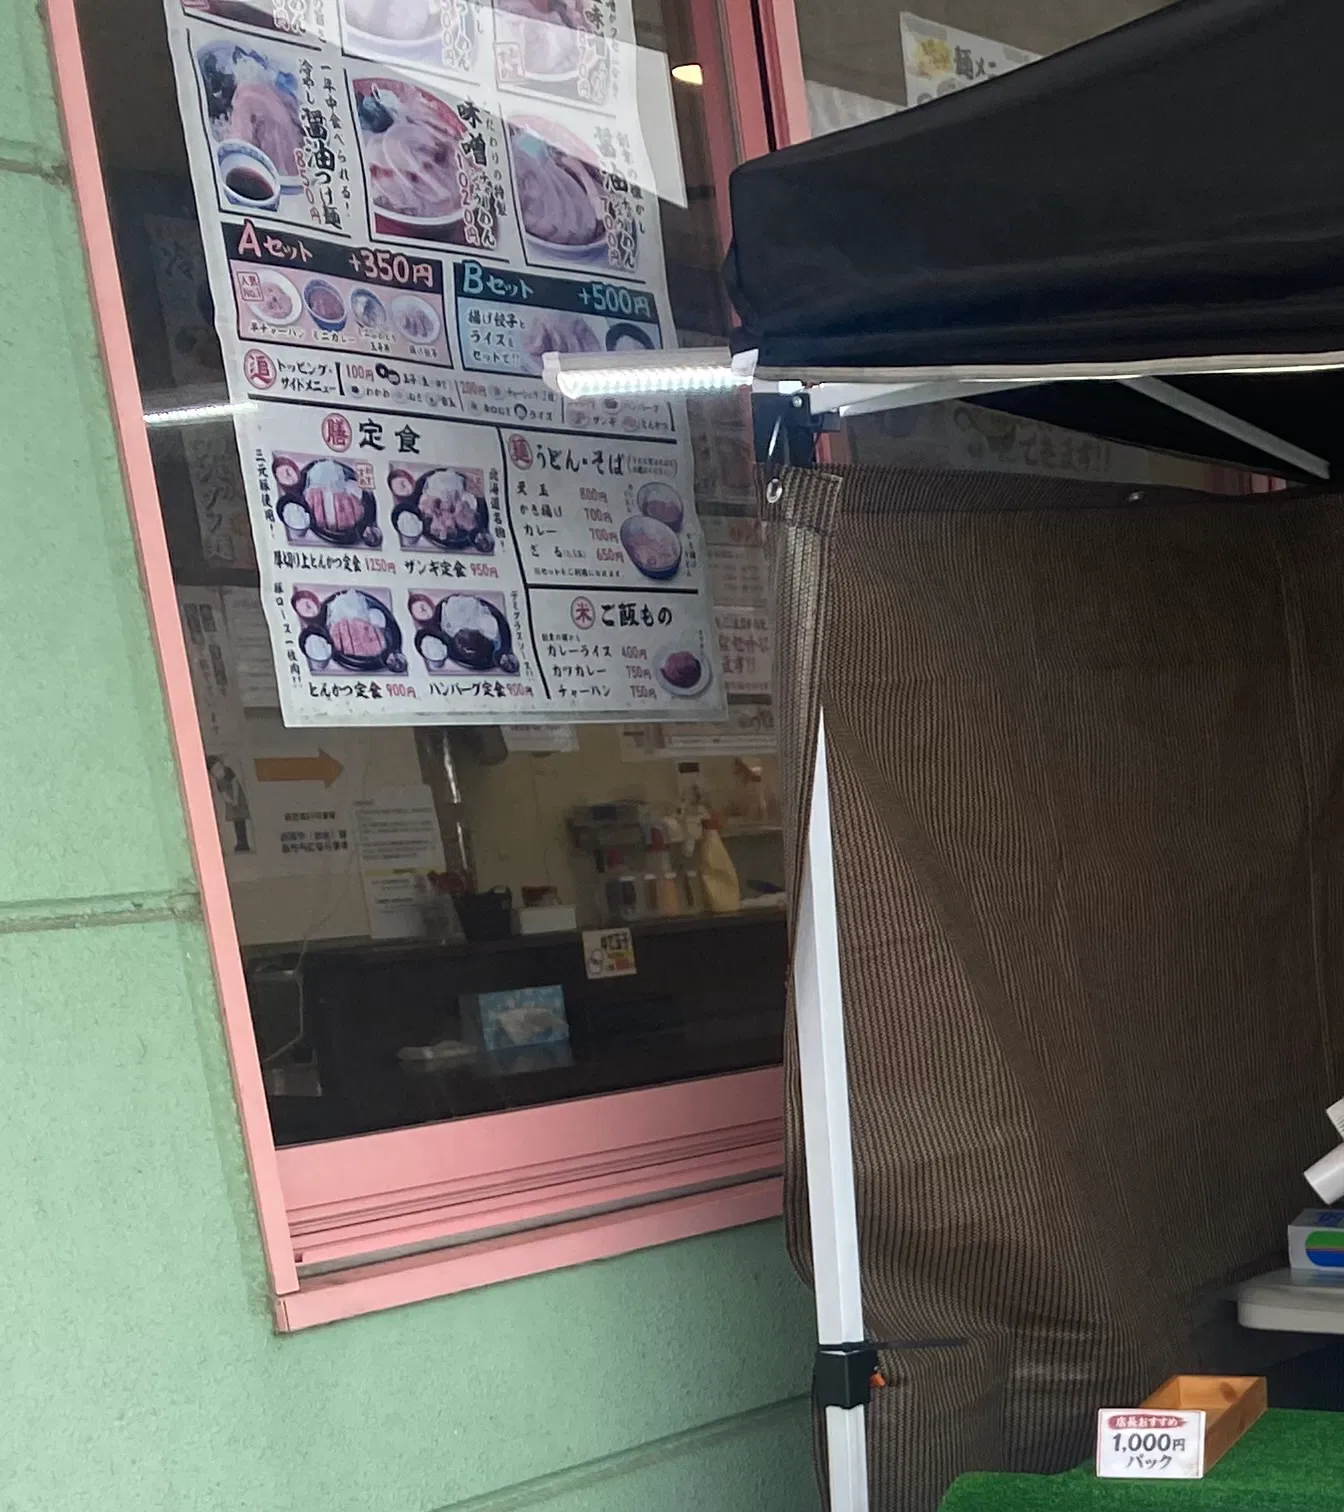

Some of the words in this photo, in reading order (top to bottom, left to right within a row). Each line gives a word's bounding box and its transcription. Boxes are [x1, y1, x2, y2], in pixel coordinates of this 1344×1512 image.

[238, 219, 313, 263] Aセット
[349, 249, 433, 287] +350円
[463, 262, 534, 299] Bセット
[578, 284, 650, 316] +500円
[358, 418, 421, 454] 定食
[524, 524, 557, 536] カレー
[404, 559, 466, 577] ザンギ定食
[601, 603, 673, 627] ご飯もの
[547, 644, 612, 658] カレーライス
[308, 682, 383, 699] とんかつ定食
[1116, 1416, 1178, 1428] 店長おすすめ
[1112, 1433, 1186, 1453] 1,000円
[1127, 1455, 1172, 1469] パック
